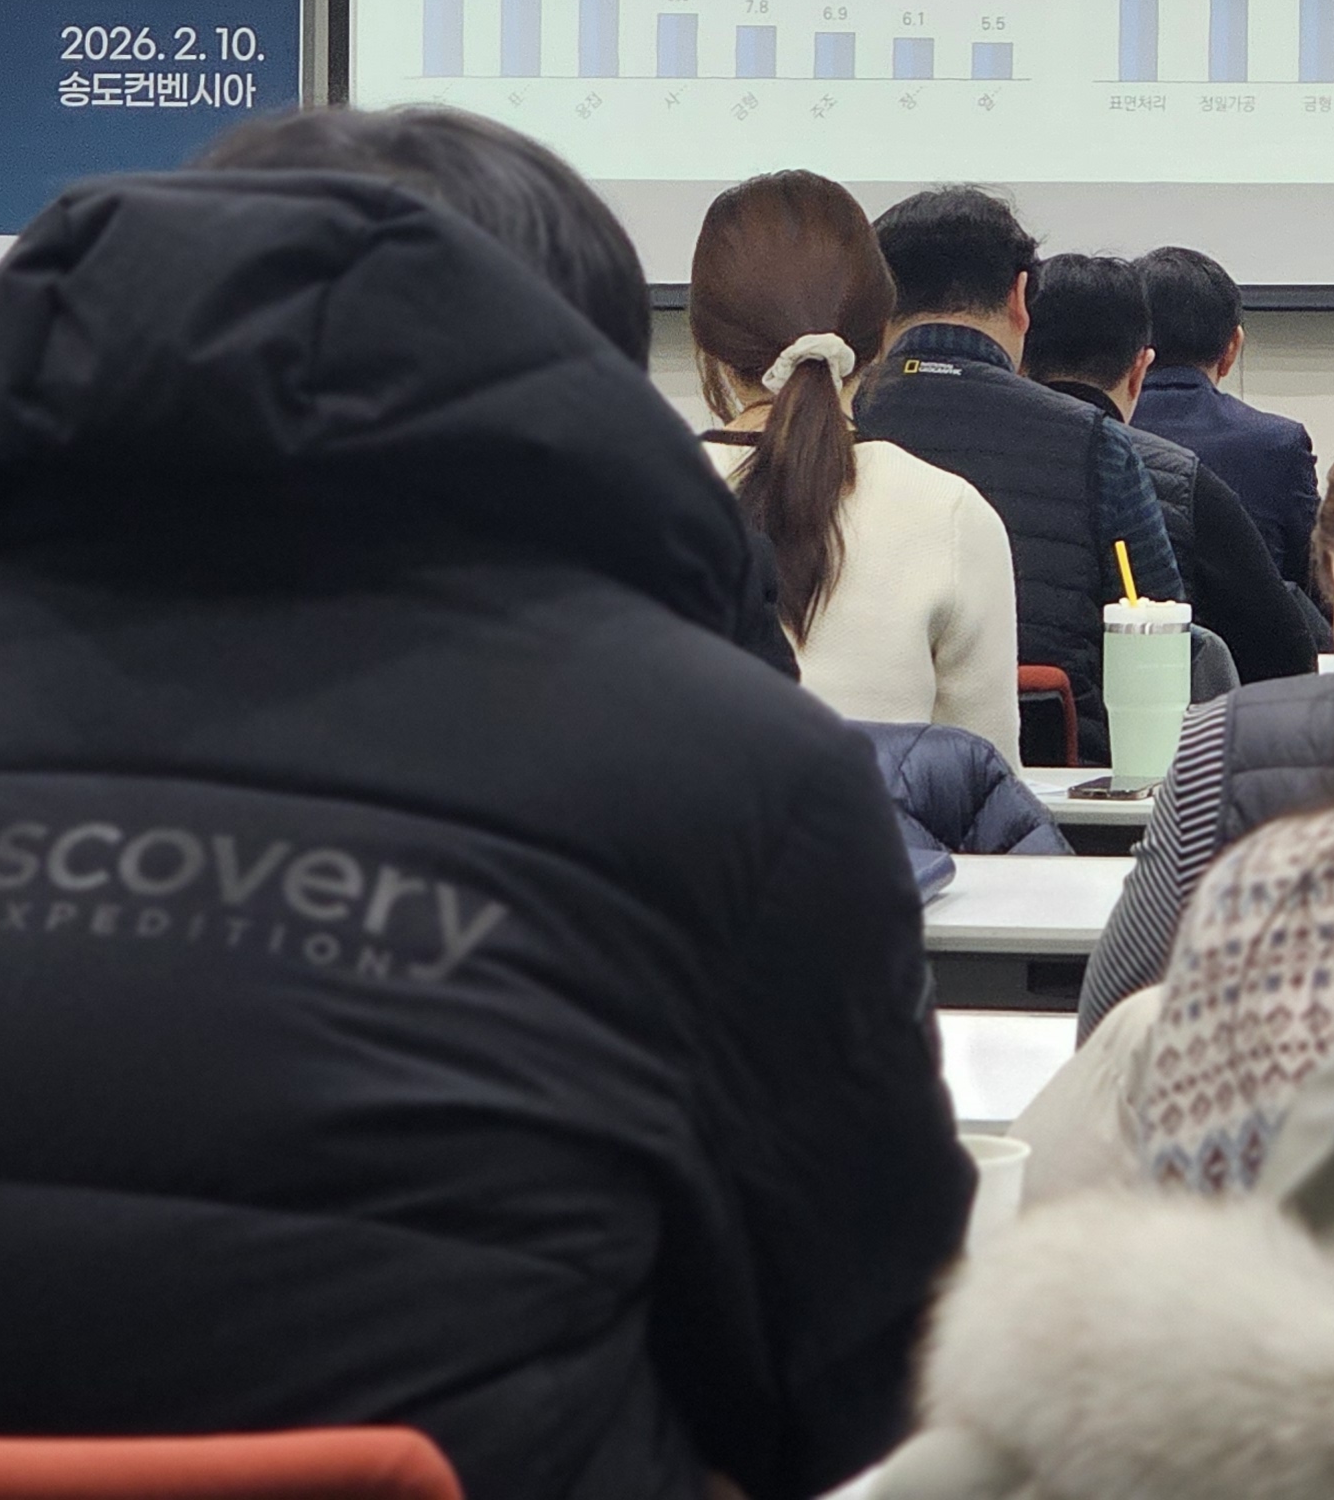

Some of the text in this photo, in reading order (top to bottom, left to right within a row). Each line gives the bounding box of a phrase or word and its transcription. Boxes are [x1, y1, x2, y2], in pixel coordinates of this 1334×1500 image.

[746, 0, 769, 14] 7.8
[823, 6, 847, 20] 6.9
[902, 11, 924, 26] 6.1
[982, 16, 1005, 31] 5.5
[61, 26, 264, 61] 2026. 2. 10.
[59, 71, 256, 108] 송도컨벤시아
